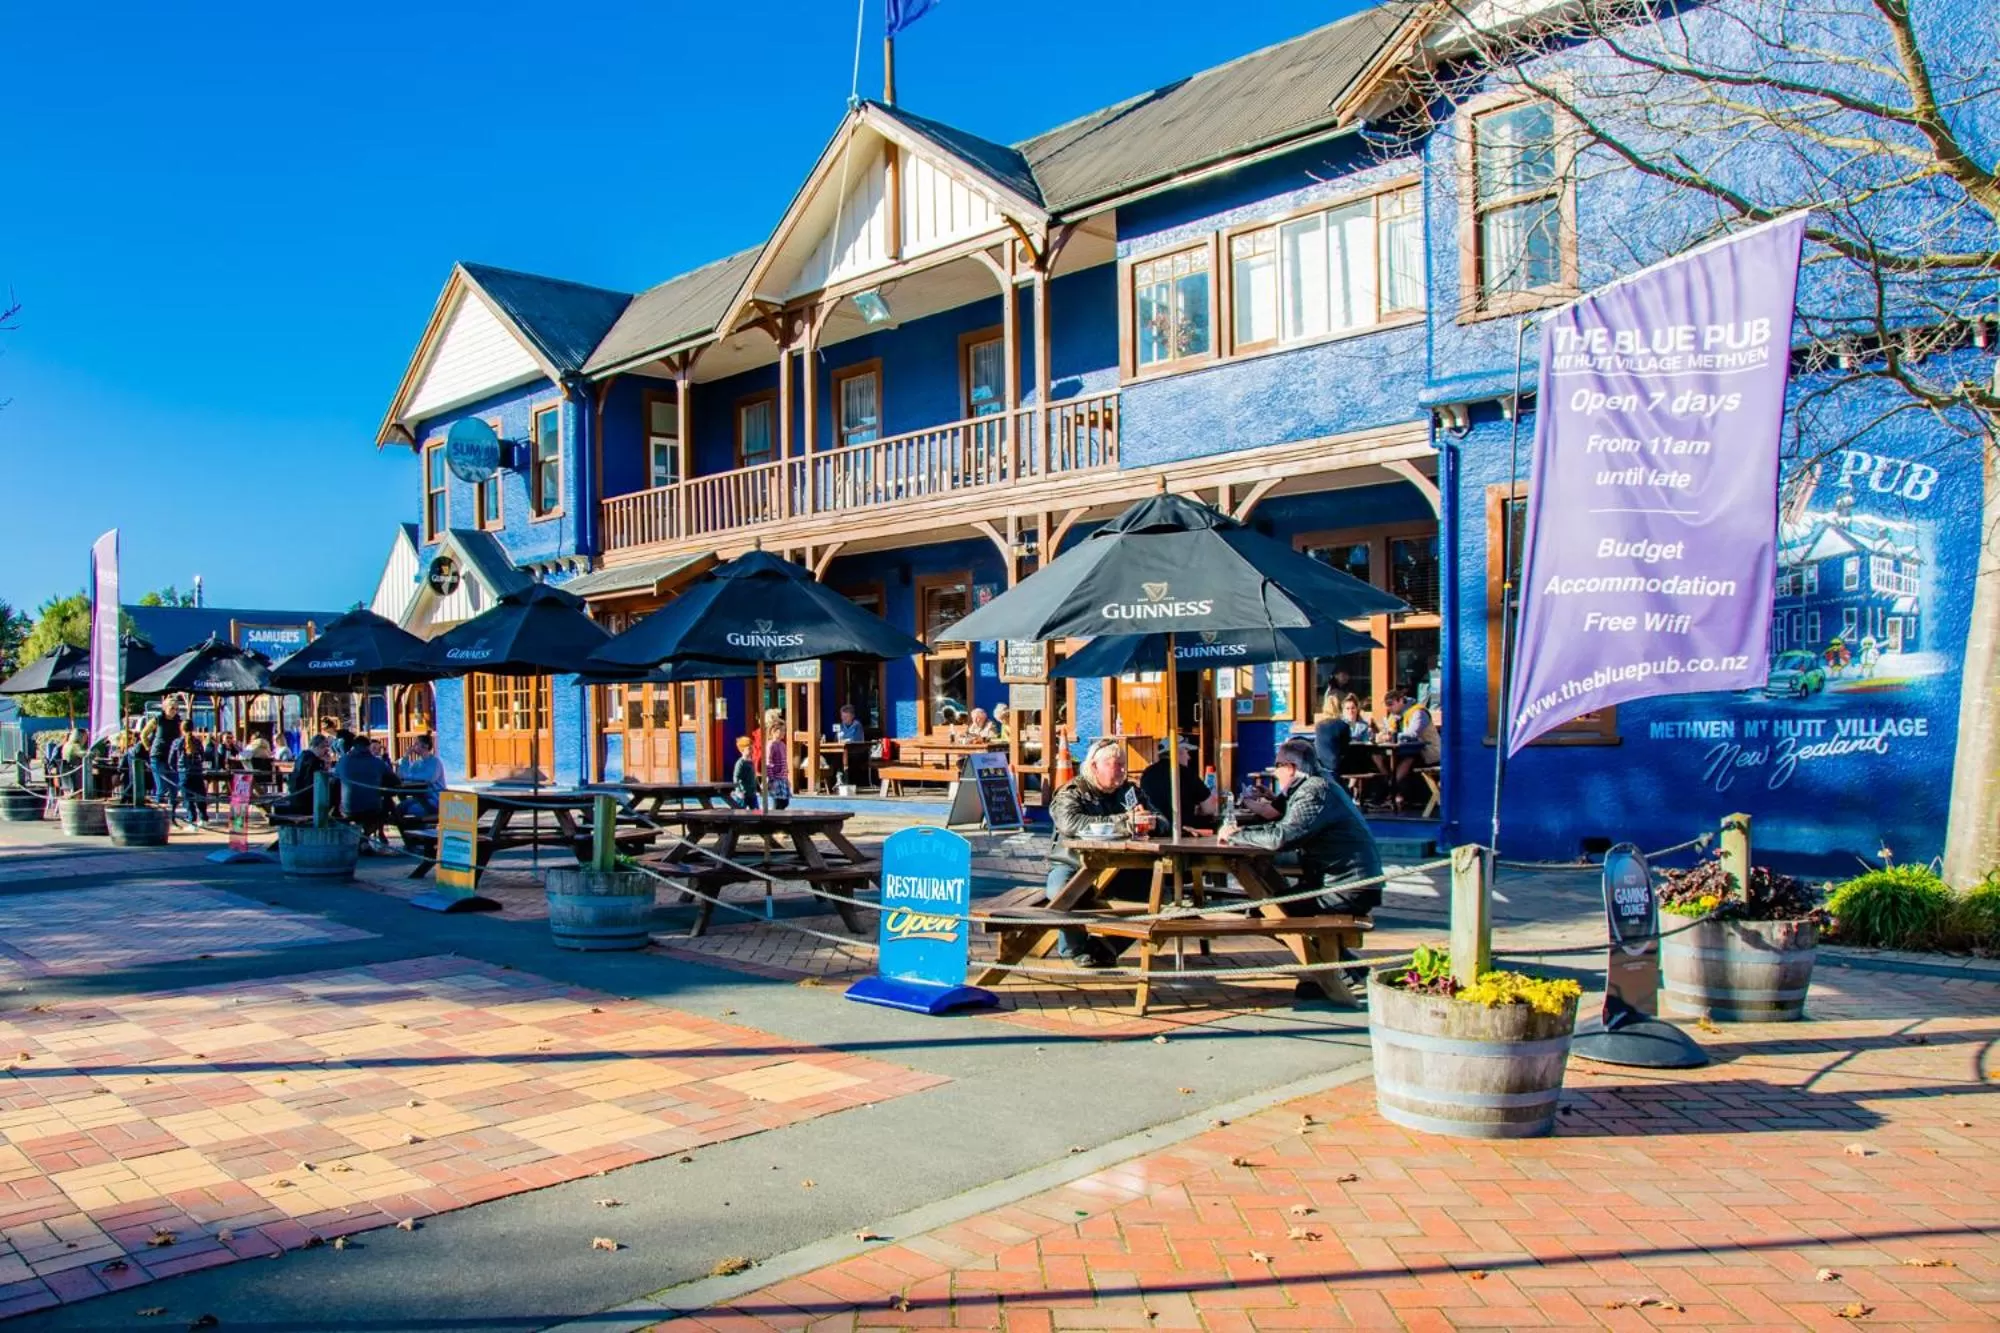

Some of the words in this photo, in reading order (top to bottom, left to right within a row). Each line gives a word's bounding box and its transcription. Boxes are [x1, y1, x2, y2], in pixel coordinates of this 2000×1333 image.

[1554, 326, 1608, 353] THE
[1614, 325, 1696, 355] BLUE
[1703, 317, 1772, 351] PUB
[1575, 355, 1614, 370] HUTT
[1615, 356, 1682, 371] VILLAGE
[1688, 347, 1769, 369] METHVEN
[1570, 388, 1639, 415] Open
[1647, 392, 1666, 411] 7
[1671, 390, 1742, 418] days
[1586, 434, 1642, 454] From
[1650, 436, 1711, 455] 11am
[1596, 467, 1644, 486] until
[1648, 469, 1692, 488] late
[1832, 450, 1940, 502] PUB
[1597, 538, 1685, 563] Budget
[1544, 575, 1736, 597] Accommodation
[1102, 600, 1213, 619] GUINNESS
[1584, 612, 1637, 633] Free
[1644, 613, 1693, 634] Wifi
[248, 630, 300, 643] SAMUEL'S
[726, 633, 805, 648] GUINNESS
[1174, 644, 1248, 658] GUINNESS
[1516, 655, 1750, 728] www.thebluepub.co.nz
[1650, 720, 1736, 739] METHVEN
[1773, 719, 1827, 738] HUTT
[1835, 718, 1928, 737] VILLAGE
[1703, 742, 1770, 792] New
[1768, 733, 1888, 790] Zealand
[886, 874, 965, 905] RESTAURANT
[1615, 887, 1649, 905] GAMING
[1621, 903, 1647, 917] LOUNGE
[886, 907, 960, 938] Open
